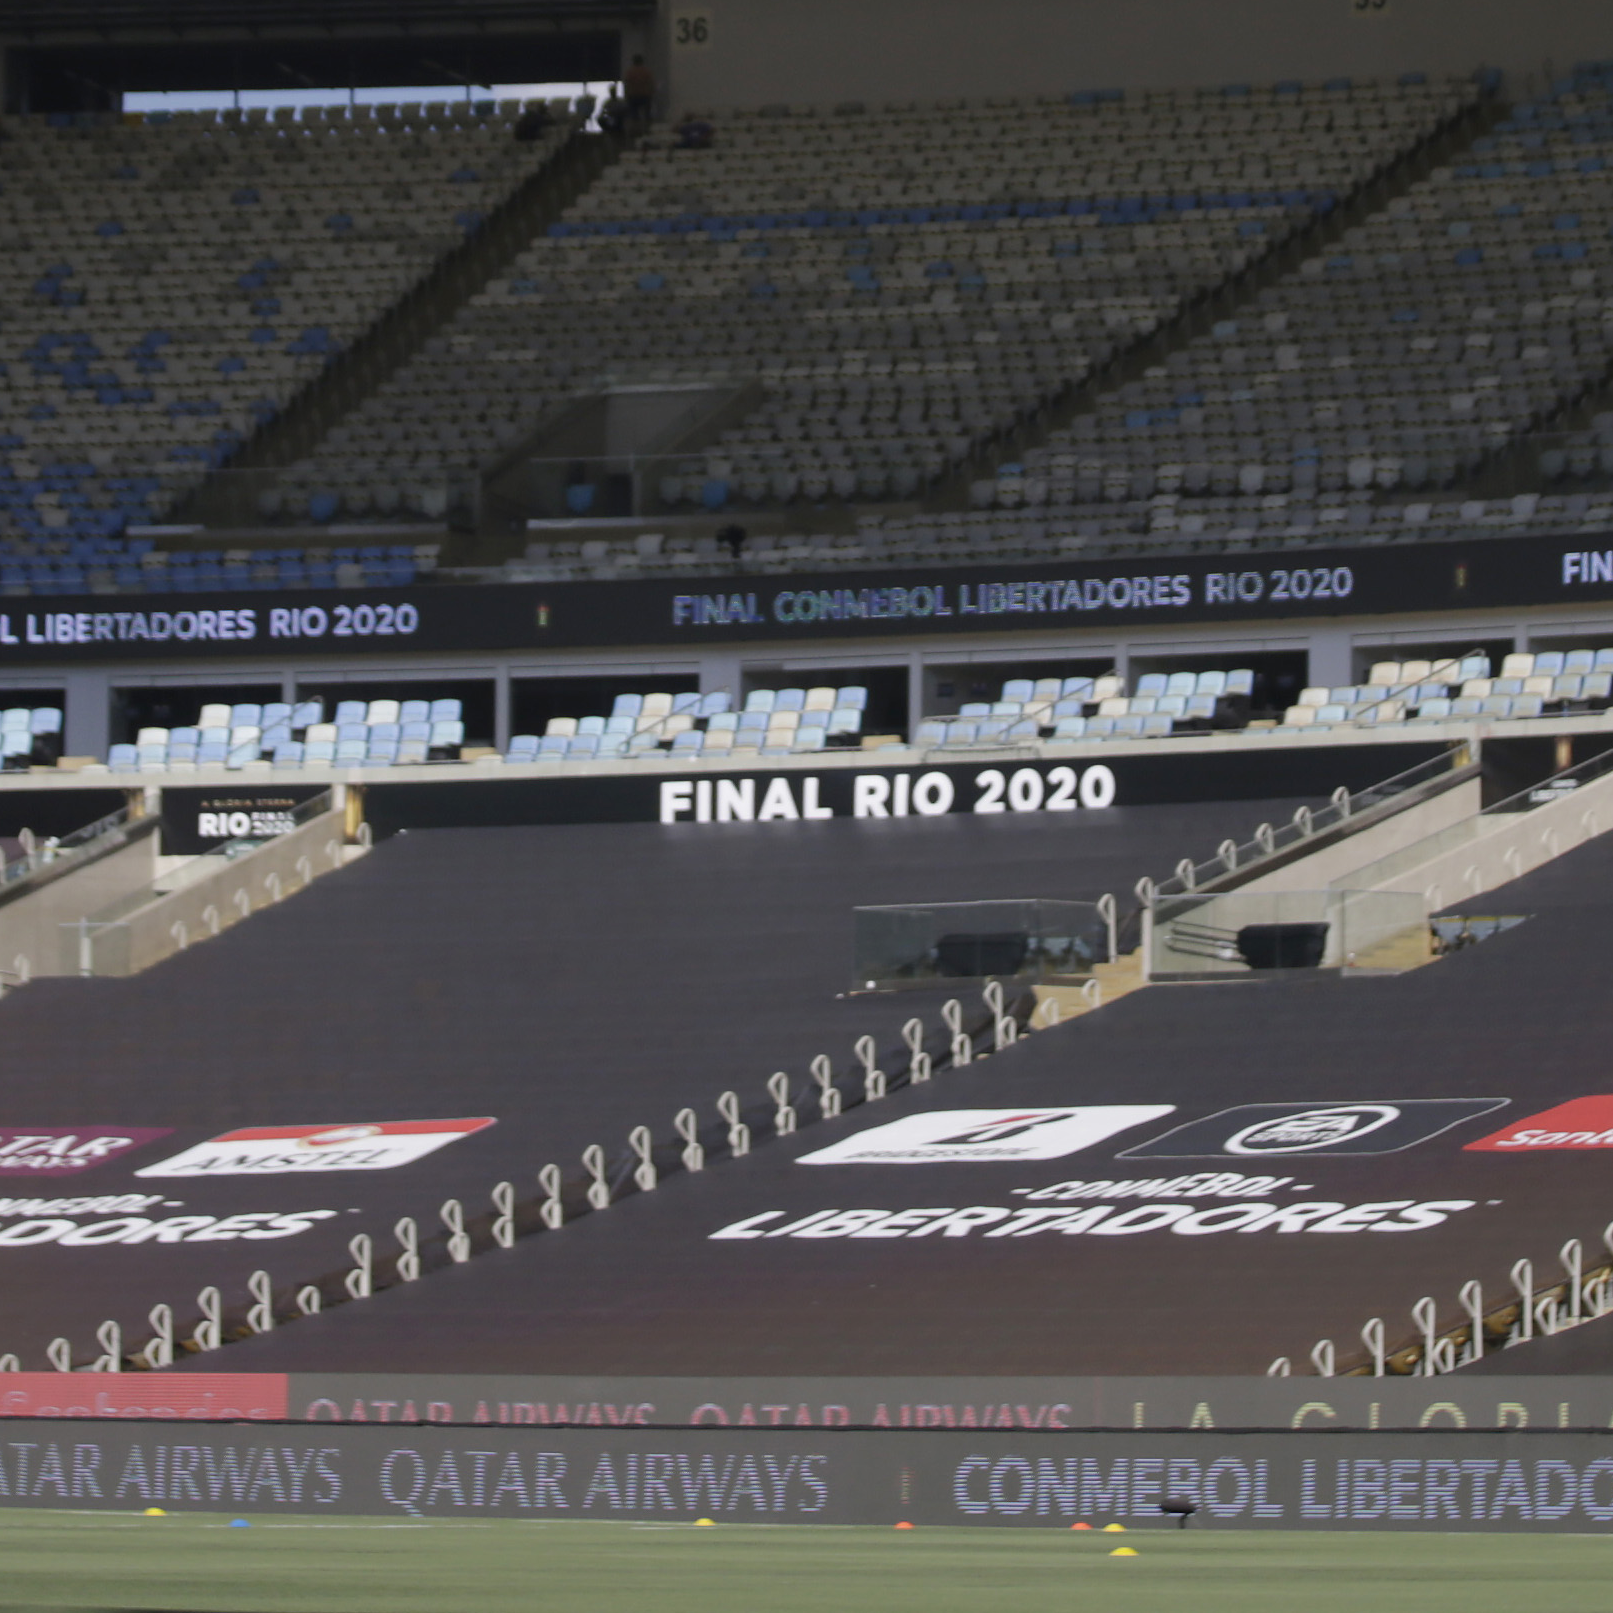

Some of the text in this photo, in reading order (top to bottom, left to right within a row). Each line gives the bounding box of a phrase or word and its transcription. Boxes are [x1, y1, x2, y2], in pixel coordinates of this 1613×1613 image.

[676, 17, 708, 43] 36
[673, 567, 1353, 624] FINAL CONMEBOL LIBERTADORES RIO 2020
[26, 610, 256, 644] LIBERTADORES
[270, 606, 327, 638] RIO
[333, 604, 419, 636] 2020
[659, 764, 1116, 824] FINAL RIO 2020
[198, 812, 251, 837] RIO
[172, 1149, 390, 1171] AMSTEL
[1026, 1173, 1293, 1201] CONMEBOL
[708, 1199, 1473, 1240] LIBERTADORES
[115, 1441, 343, 1503] AIRWAYS
[379, 1447, 829, 1517] QATAR AIRWAYS
[955, 1454, 1284, 1517] CONMEBOL
